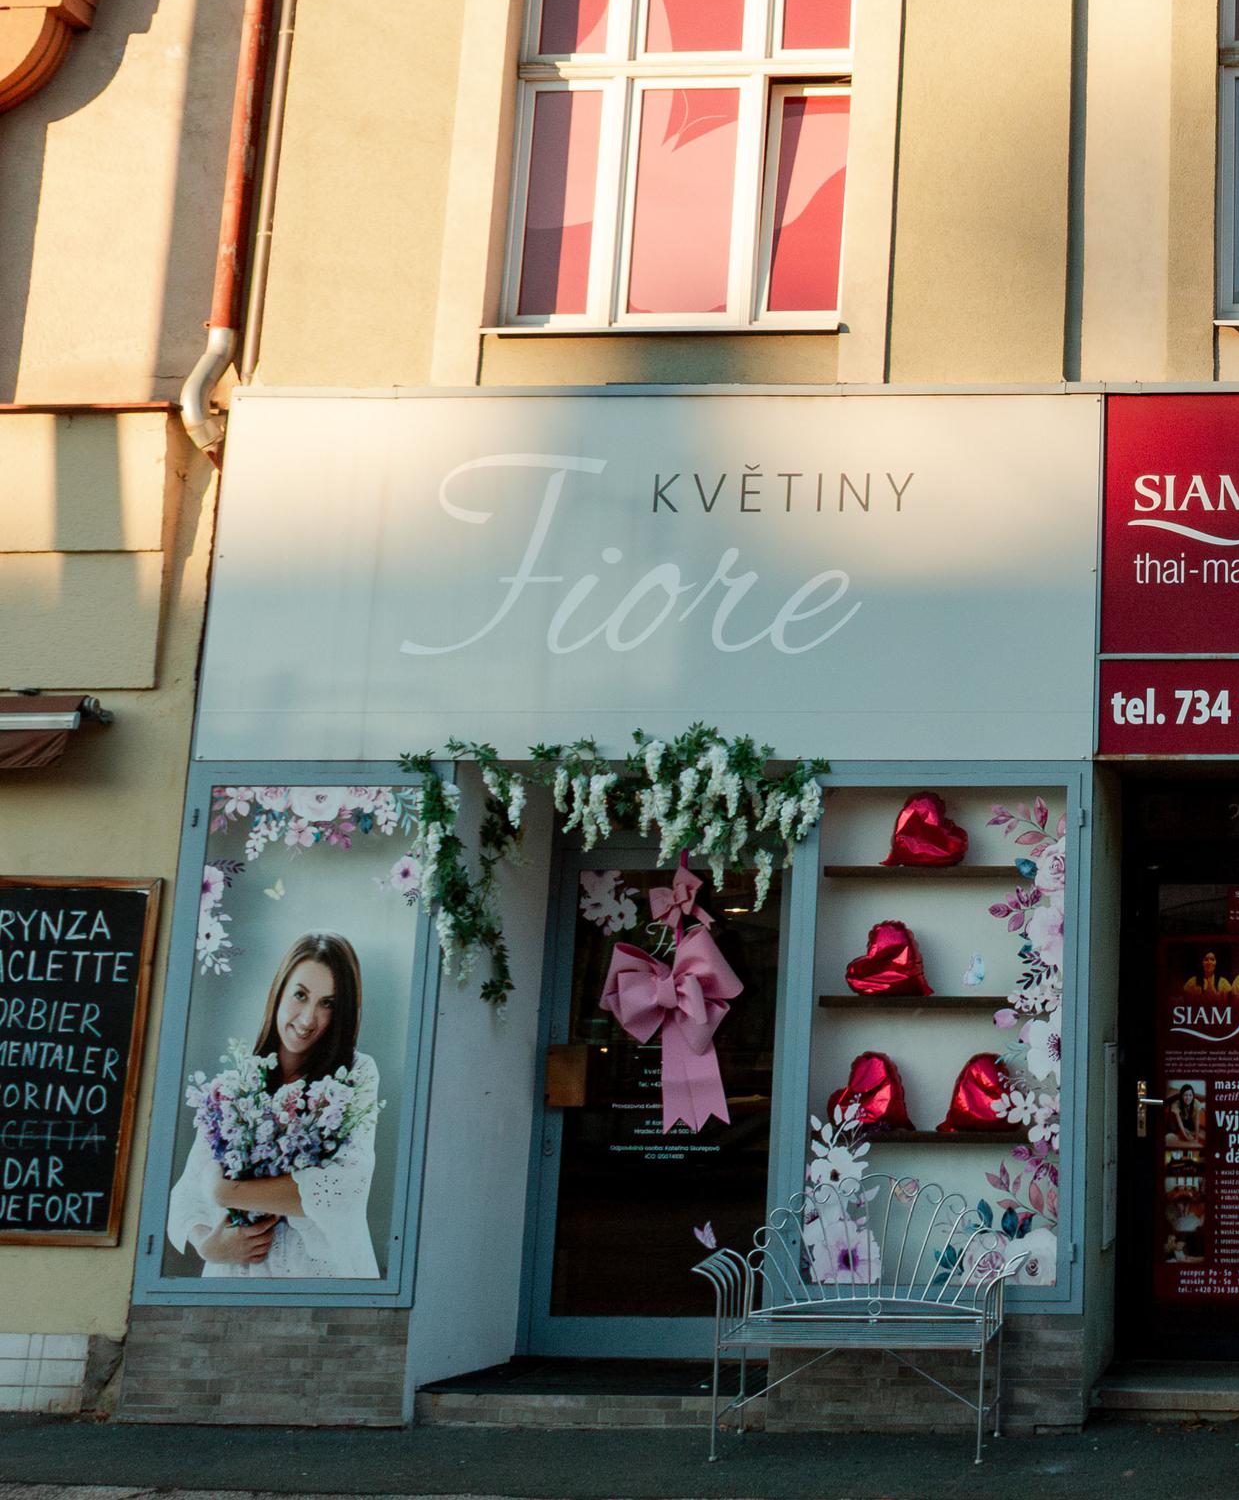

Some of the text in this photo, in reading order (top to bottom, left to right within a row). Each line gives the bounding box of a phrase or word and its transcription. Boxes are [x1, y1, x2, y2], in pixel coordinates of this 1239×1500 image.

[652, 463, 915, 514] KVĚTINY
[399, 452, 864, 656] Fiore
[1111, 688, 1166, 725] tel.
[1174, 689, 1232, 725] 734
[0, 950, 134, 983] CLETTE
[1172, 1006, 1232, 1025] SIAM
